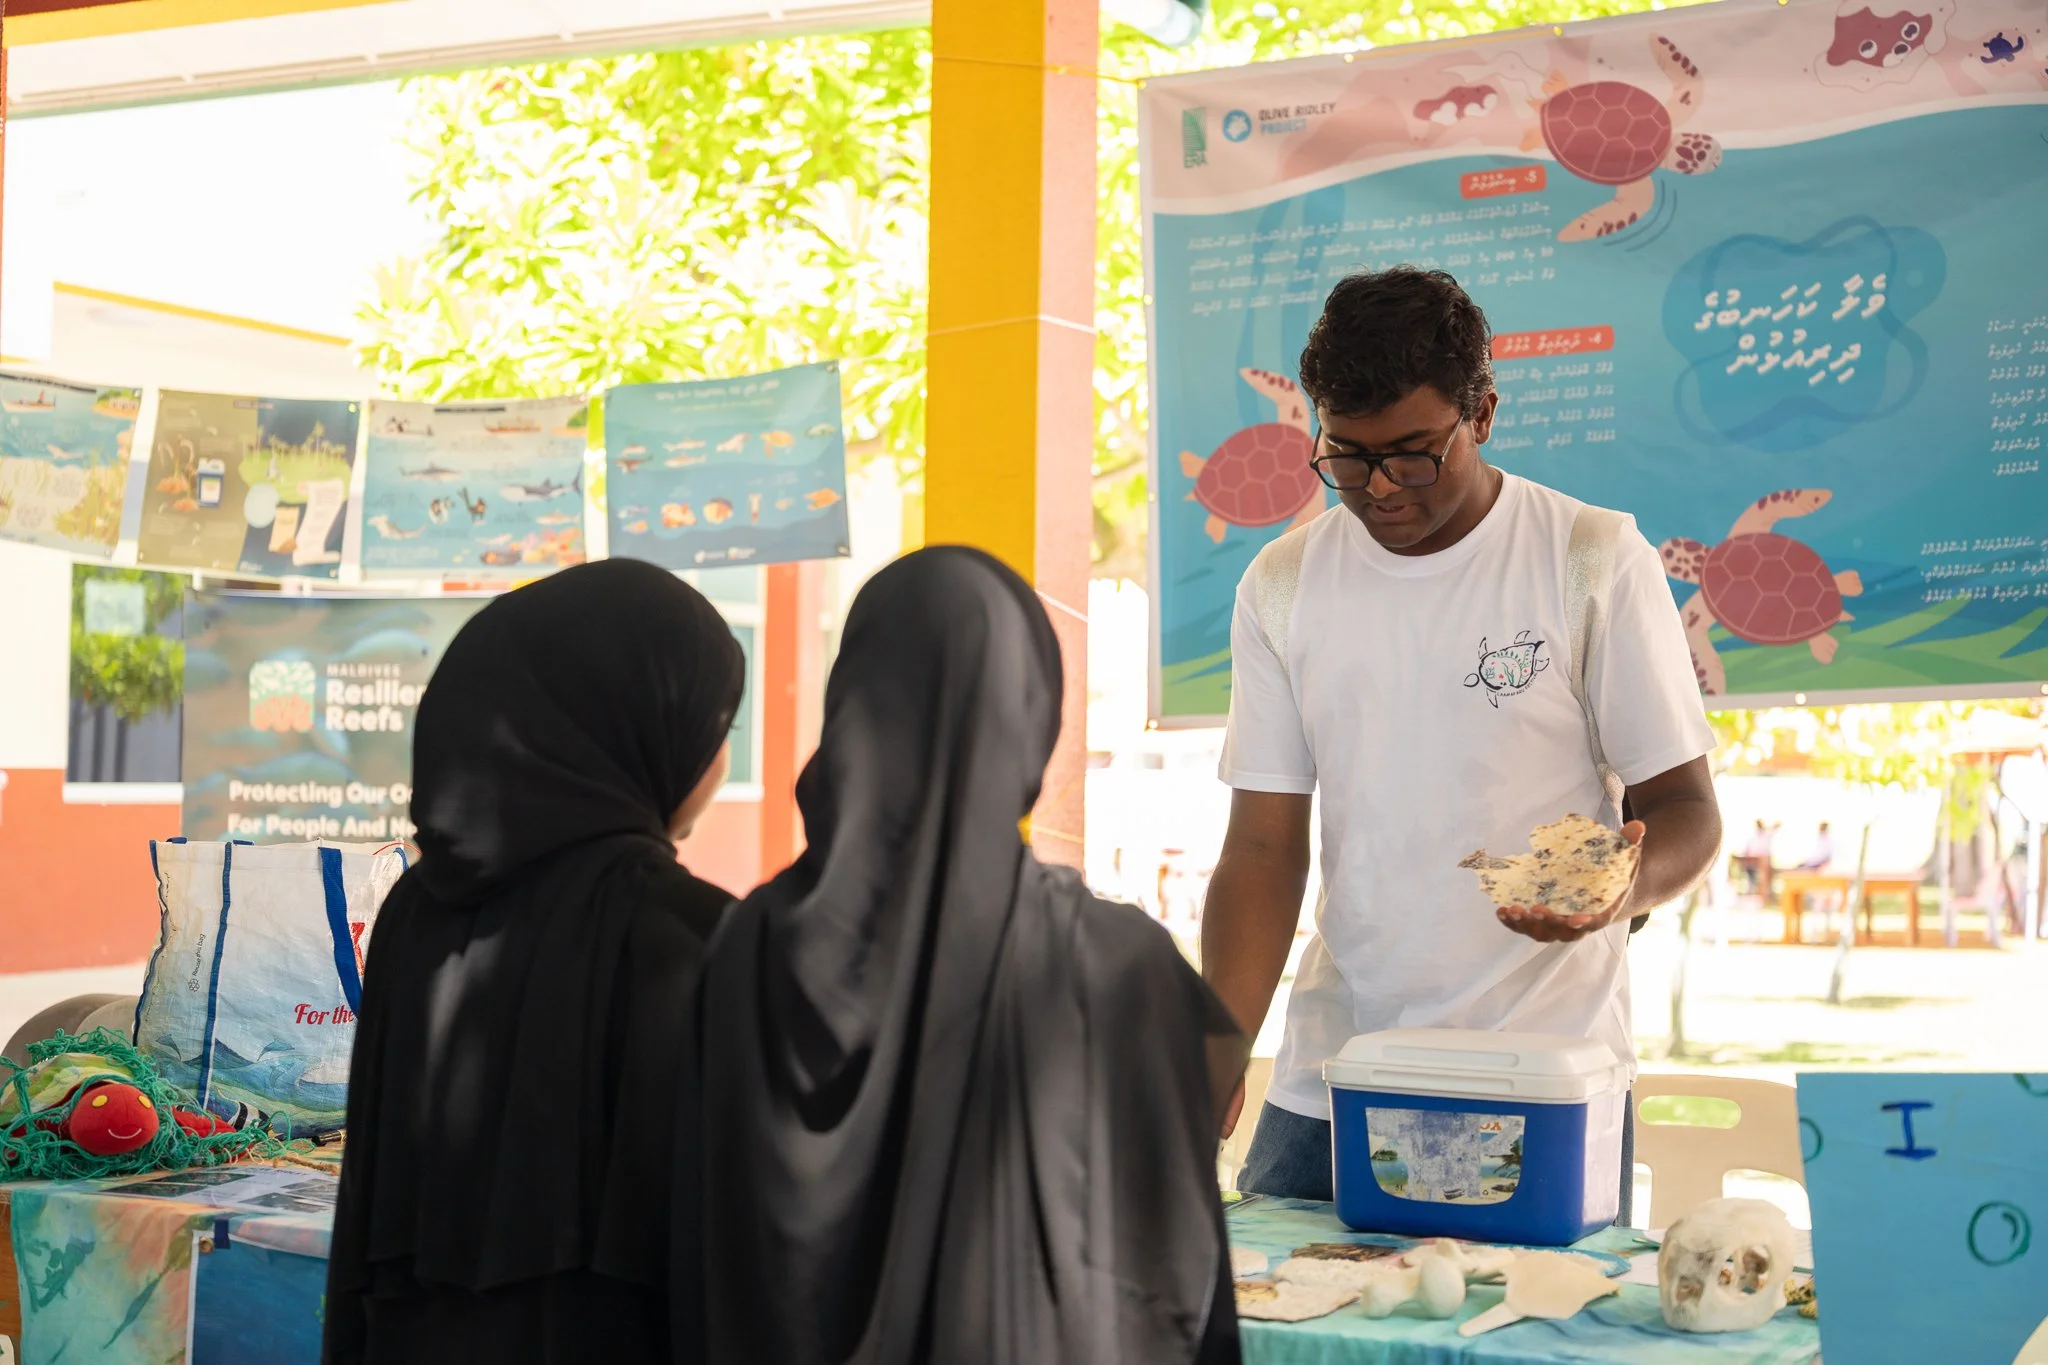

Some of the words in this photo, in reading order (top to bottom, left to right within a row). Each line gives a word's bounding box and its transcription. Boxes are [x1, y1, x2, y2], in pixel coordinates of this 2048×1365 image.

[1258, 106, 1290, 121] OLIVE
[1295, 102, 1337, 117] RIDLEY
[327, 663, 400, 678] MALDIVES
[325, 705, 404, 732] Reefs
[229, 780, 343, 808] Protecting
[346, 782, 387, 804] Our
[227, 813, 263, 835] For
[265, 814, 340, 840] People
[342, 815, 387, 838] And
[294, 1003, 330, 1025] For
[331, 1004, 355, 1025] the
